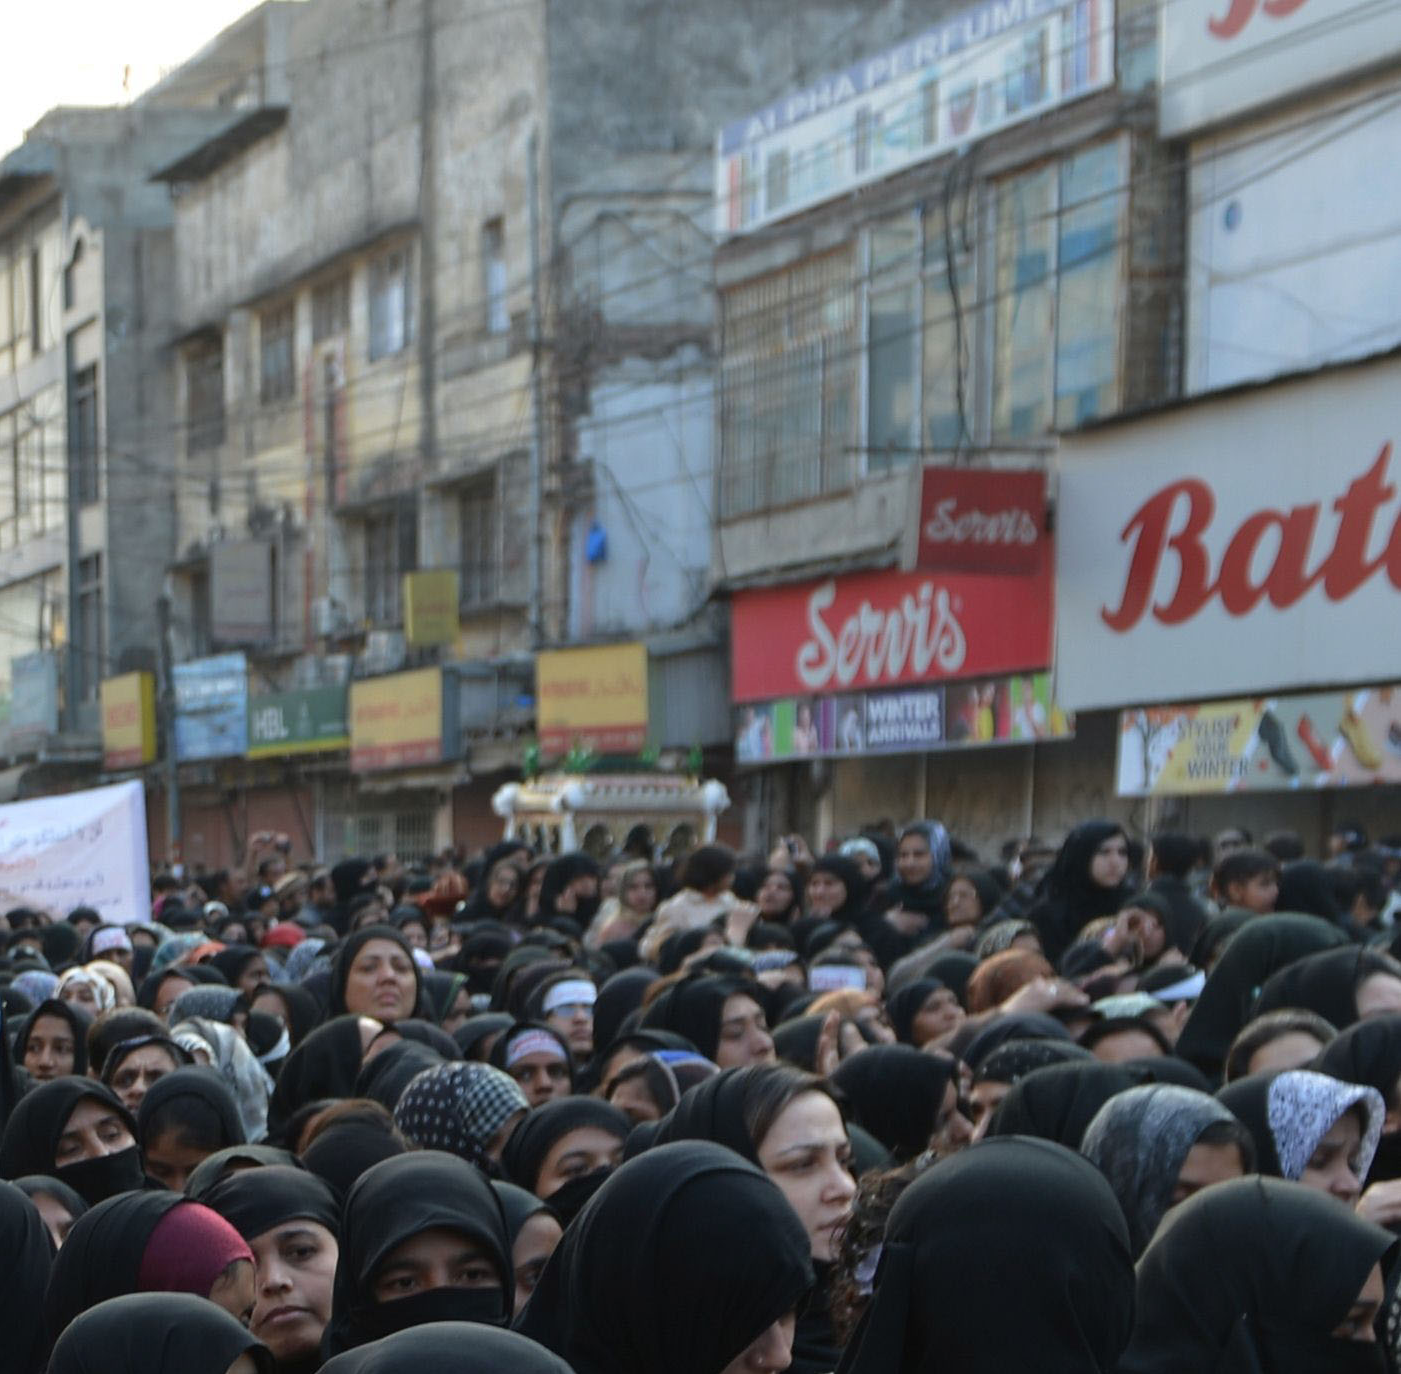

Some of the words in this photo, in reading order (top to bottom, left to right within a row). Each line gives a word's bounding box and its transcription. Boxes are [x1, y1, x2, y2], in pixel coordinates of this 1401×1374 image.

[927, 498, 1038, 546] Servis
[1101, 438, 1401, 634] Bat
[797, 578, 966, 688] Servis
[252, 707, 289, 741] HBL
[869, 695, 940, 720] WINTER
[869, 720, 941, 744] ARRIVALS
